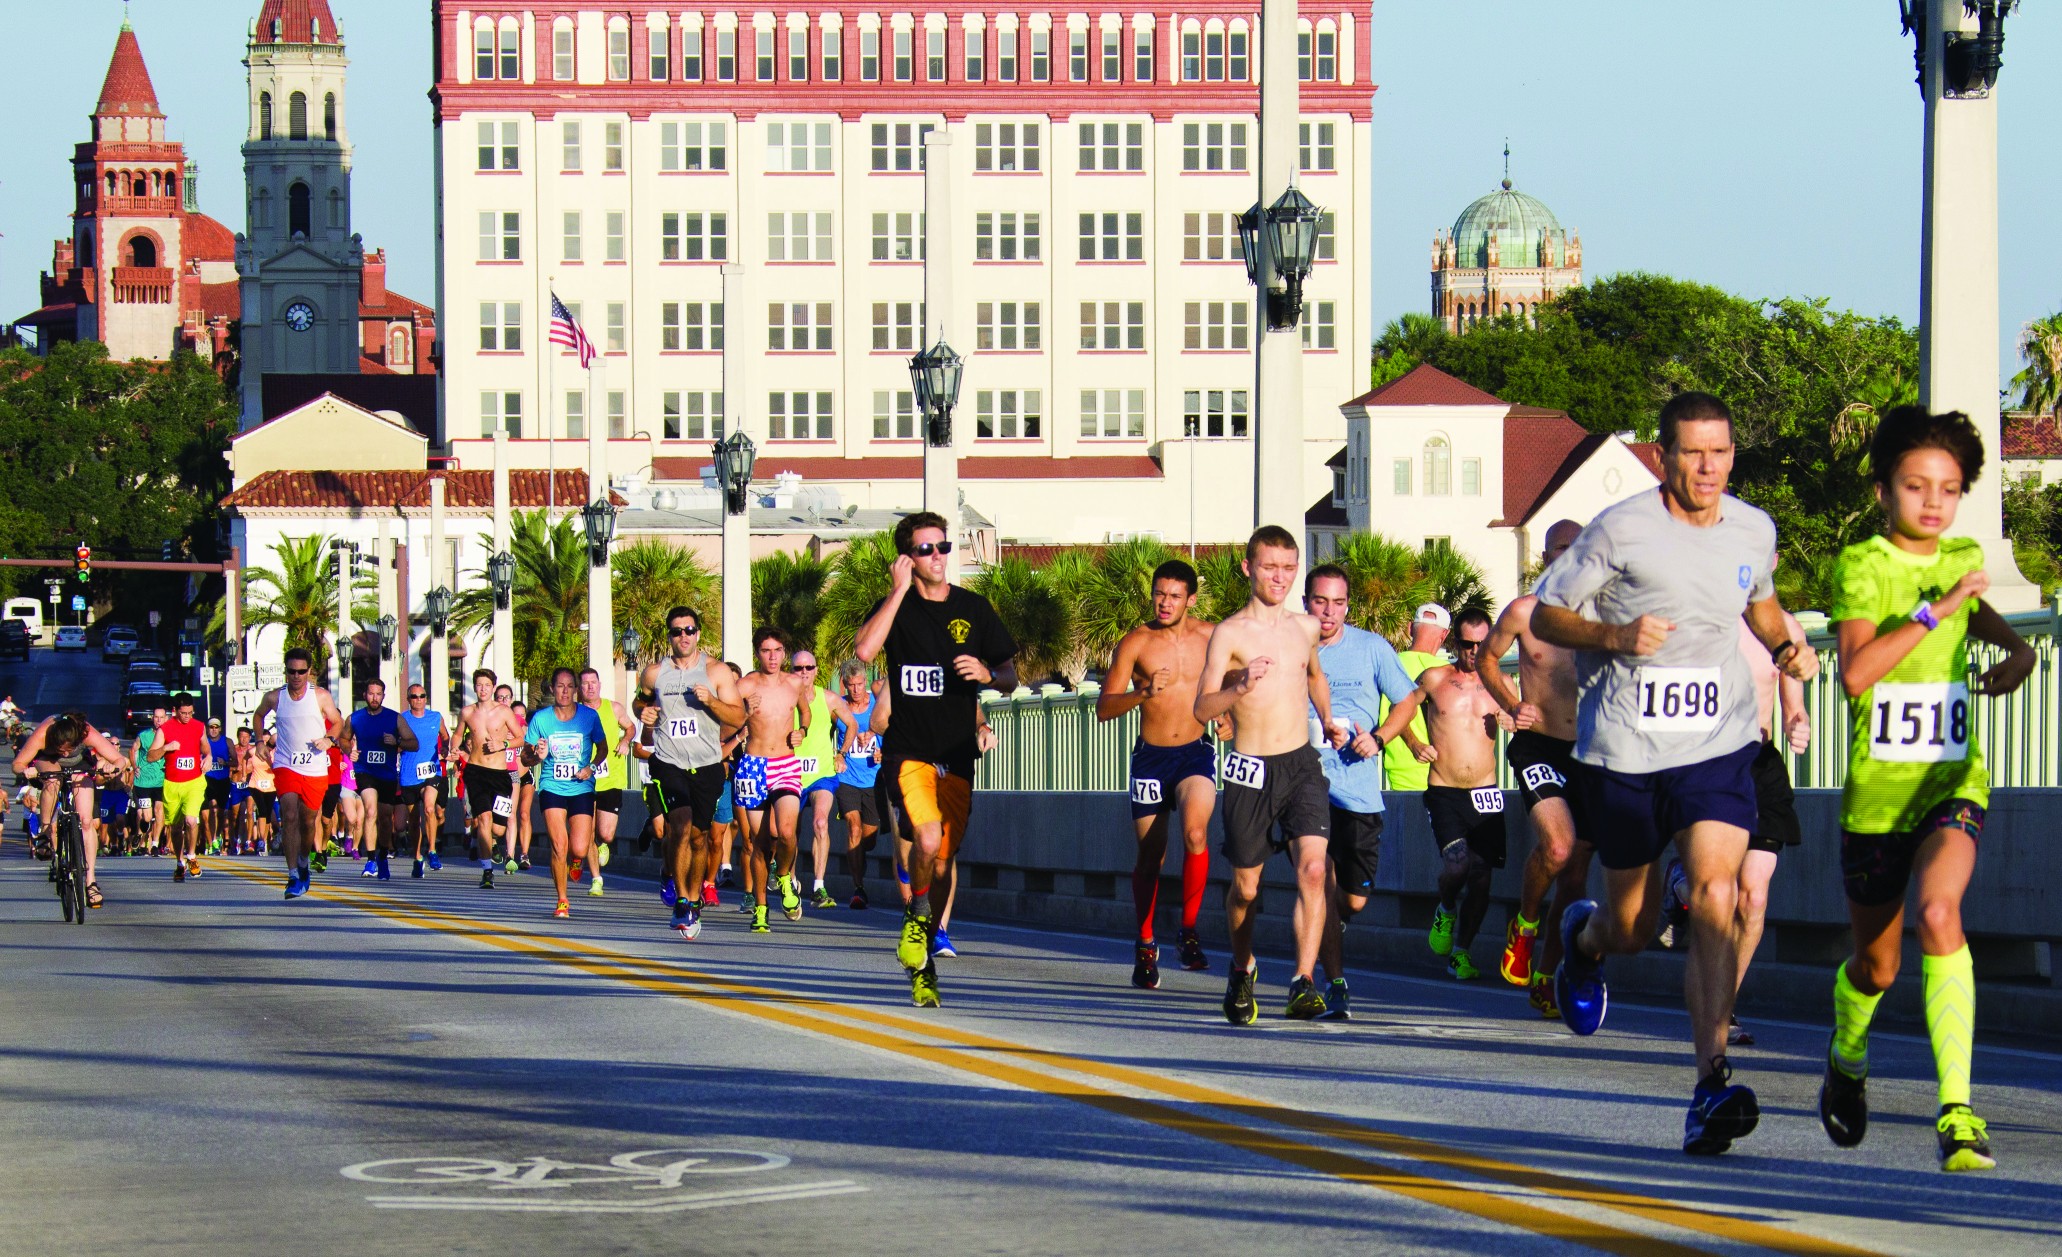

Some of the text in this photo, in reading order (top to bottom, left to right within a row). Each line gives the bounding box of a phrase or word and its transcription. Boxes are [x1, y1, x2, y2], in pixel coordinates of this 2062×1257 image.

[231, 667, 252, 676] SOUTH
[260, 665, 281, 674] NORTH
[260, 678, 283, 686] NORTH
[905, 669, 940, 693] 196
[243, 695, 247, 708] 1
[1642, 681, 1719, 718] 1698
[670, 719, 697, 736] 764
[1874, 699, 1967, 746] 1518
[177, 759, 194, 768] 548
[292, 752, 312, 765] 732
[368, 752, 385, 762] 828
[417, 763, 437, 776] 1630
[555, 765, 576, 778] 531
[1225, 754, 1260, 784] 557
[735, 780, 754, 795] 641
[1474, 791, 1502, 810] 995
